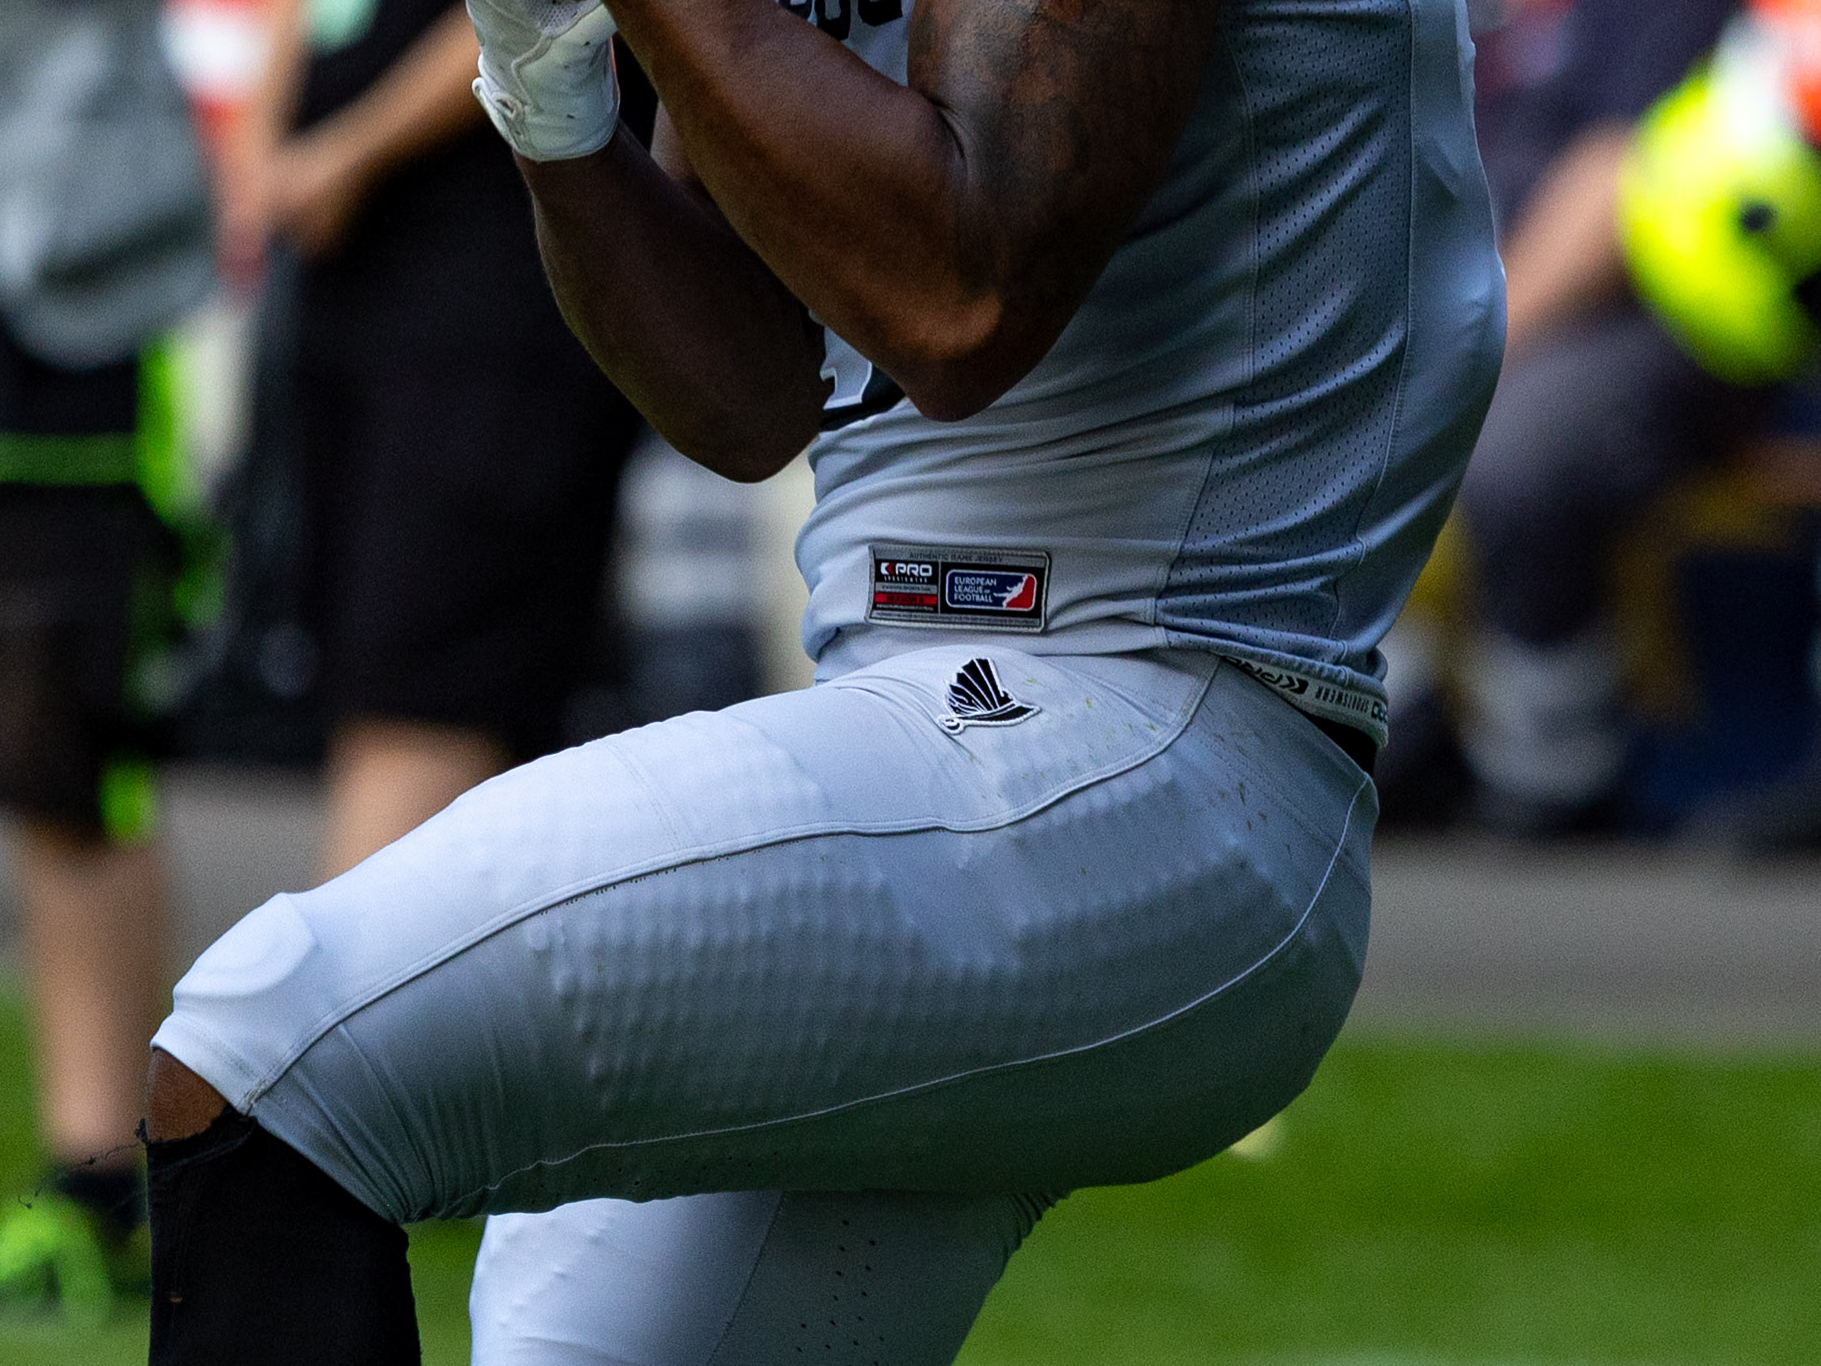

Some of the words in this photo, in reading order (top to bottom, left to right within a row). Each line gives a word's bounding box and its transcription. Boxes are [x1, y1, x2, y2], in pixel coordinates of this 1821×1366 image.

[954, 577, 997, 587] EUROPEAN
[954, 586, 985, 594] LEAGUE
[954, 593, 993, 603] FOOTBALL
